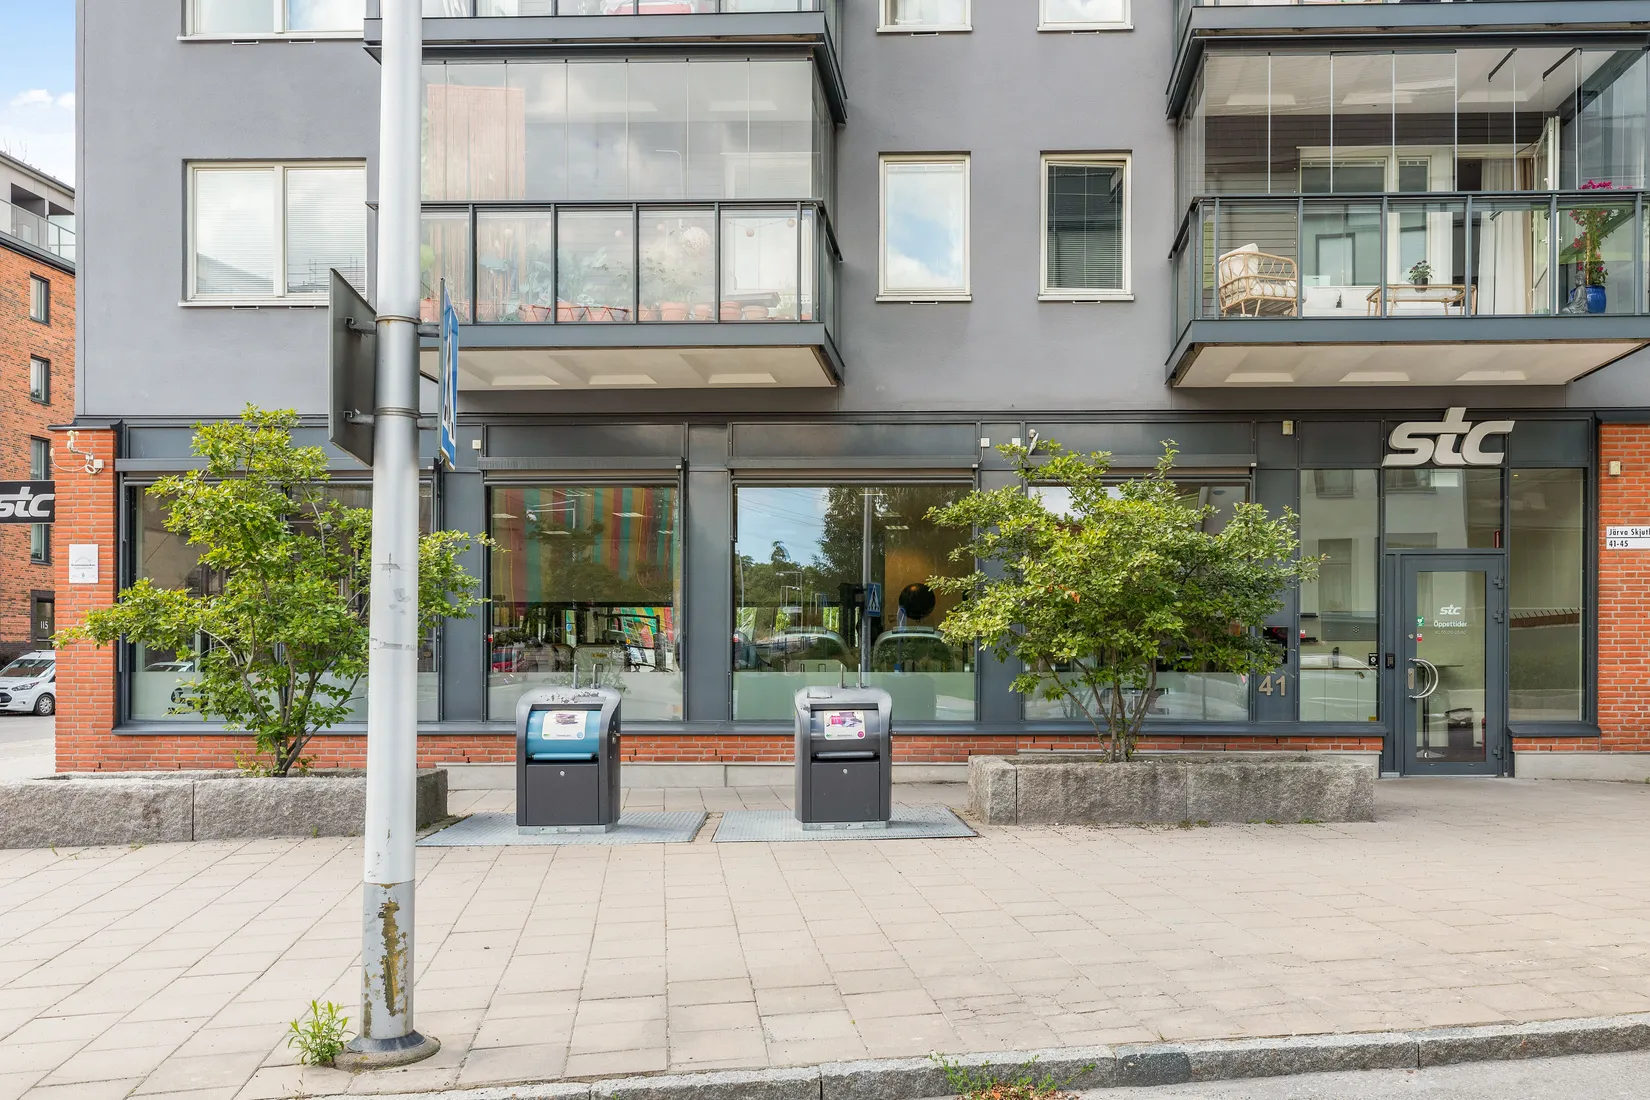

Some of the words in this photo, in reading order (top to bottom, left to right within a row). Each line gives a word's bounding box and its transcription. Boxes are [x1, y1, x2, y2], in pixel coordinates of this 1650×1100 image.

[1381, 407, 1515, 466] stc
[1630, 528, 1650, 537] Skjut
[1440, 604, 1462, 615] stc
[40, 621, 48, 630] 115
[1258, 675, 1286, 696] 41
